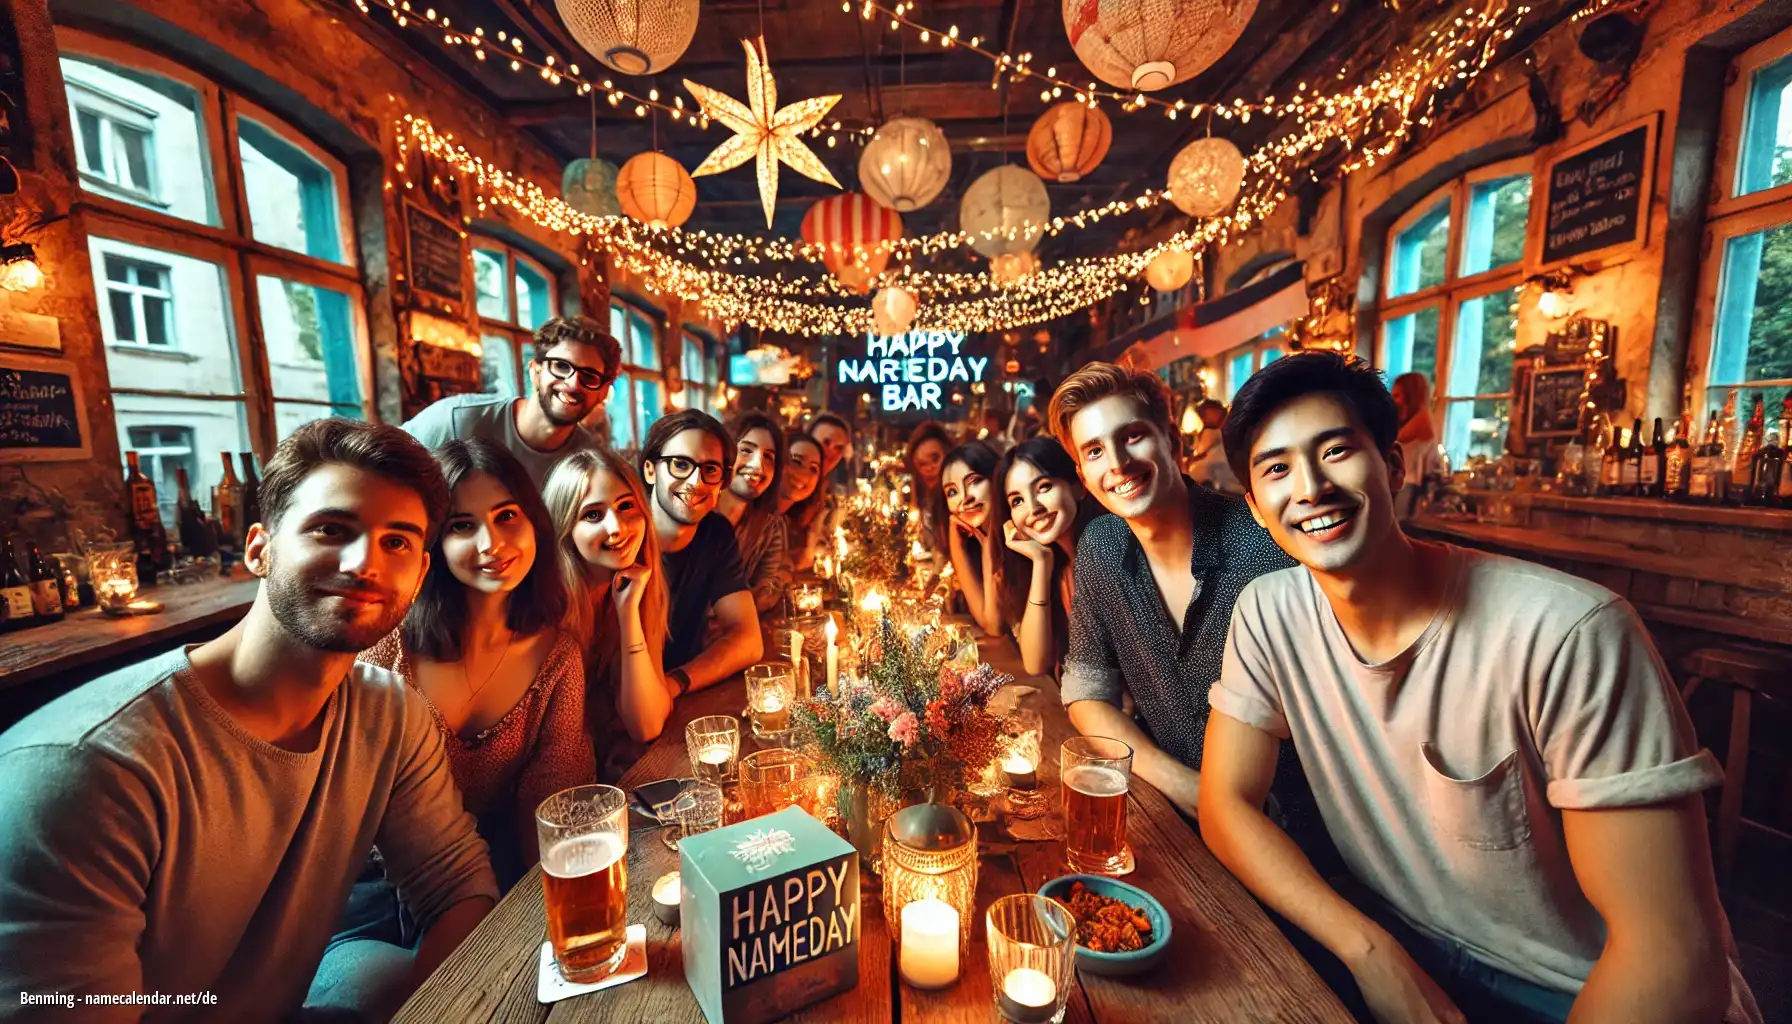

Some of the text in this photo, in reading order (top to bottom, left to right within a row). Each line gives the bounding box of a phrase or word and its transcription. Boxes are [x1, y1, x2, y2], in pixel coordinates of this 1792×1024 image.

[867, 331, 965, 357] HAPPY
[882, 382, 942, 411] BAR
[732, 860, 849, 940] HAPPY
[728, 903, 856, 987] NAMEDAY
